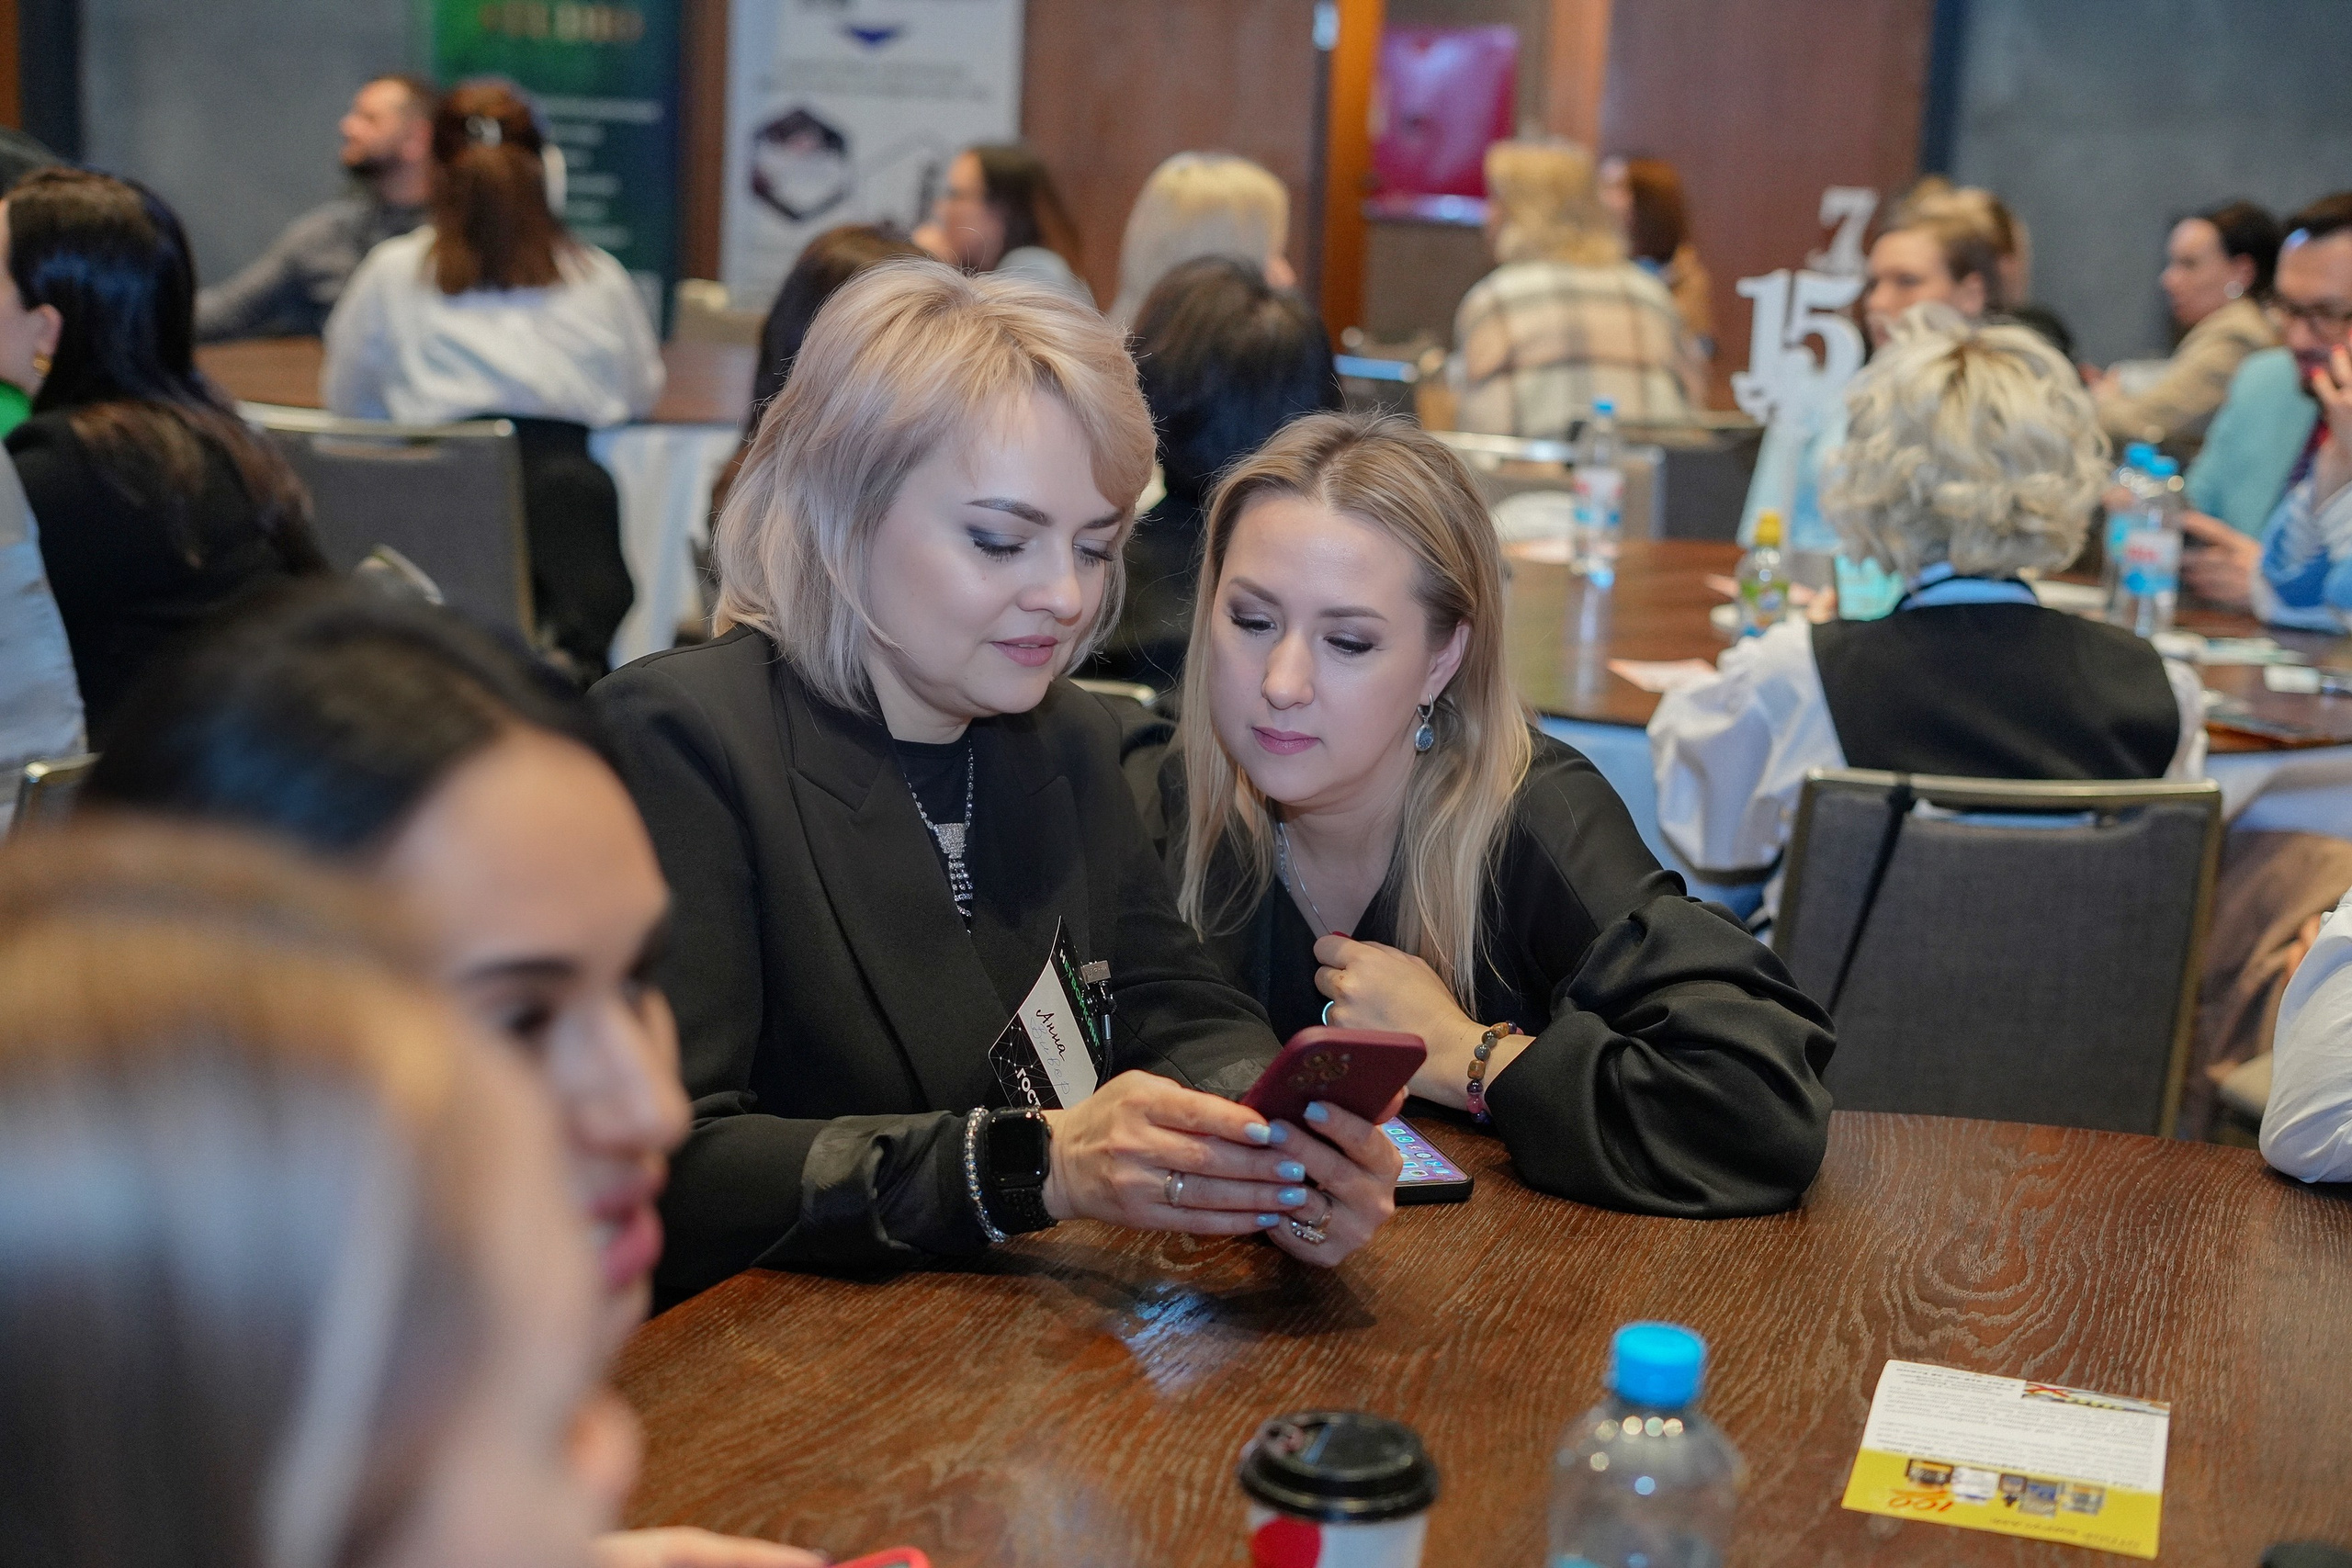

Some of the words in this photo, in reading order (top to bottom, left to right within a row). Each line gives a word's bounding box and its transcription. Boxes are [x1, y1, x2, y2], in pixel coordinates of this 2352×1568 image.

[1806, 186, 1881, 275] 7
[1735, 267, 1867, 409] 15
[1035, 1009, 1067, 1062] Анна
[1059, 948, 1101, 1047] НЕТВОРКИНГ
